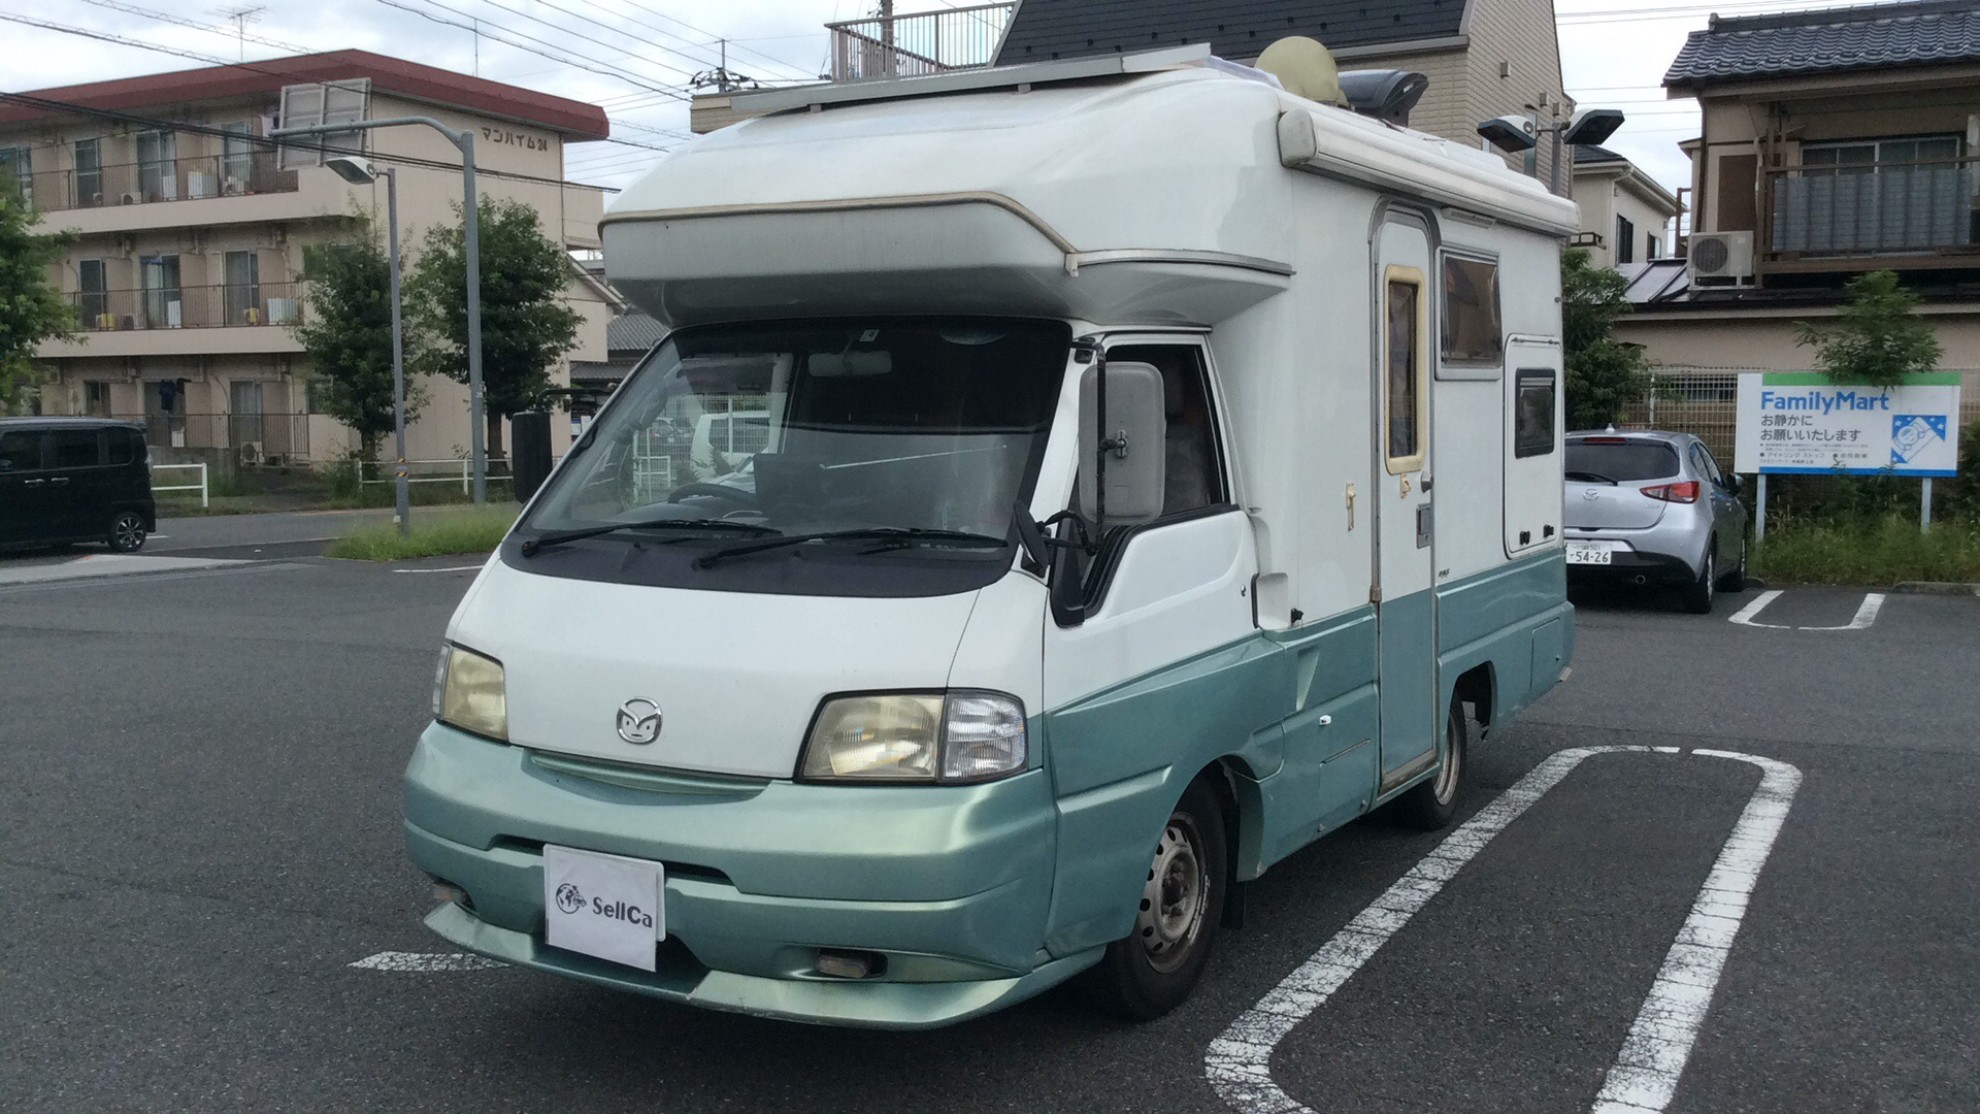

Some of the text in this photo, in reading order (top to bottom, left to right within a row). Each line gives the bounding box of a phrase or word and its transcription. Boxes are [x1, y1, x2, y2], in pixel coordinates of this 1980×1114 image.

[1761, 391, 1889, 415] FamilyMart
[1761, 414, 1813, 427] お静かに
[1760, 428, 1861, 441] お願いいたします
[593, 896, 653, 928] SellCa
